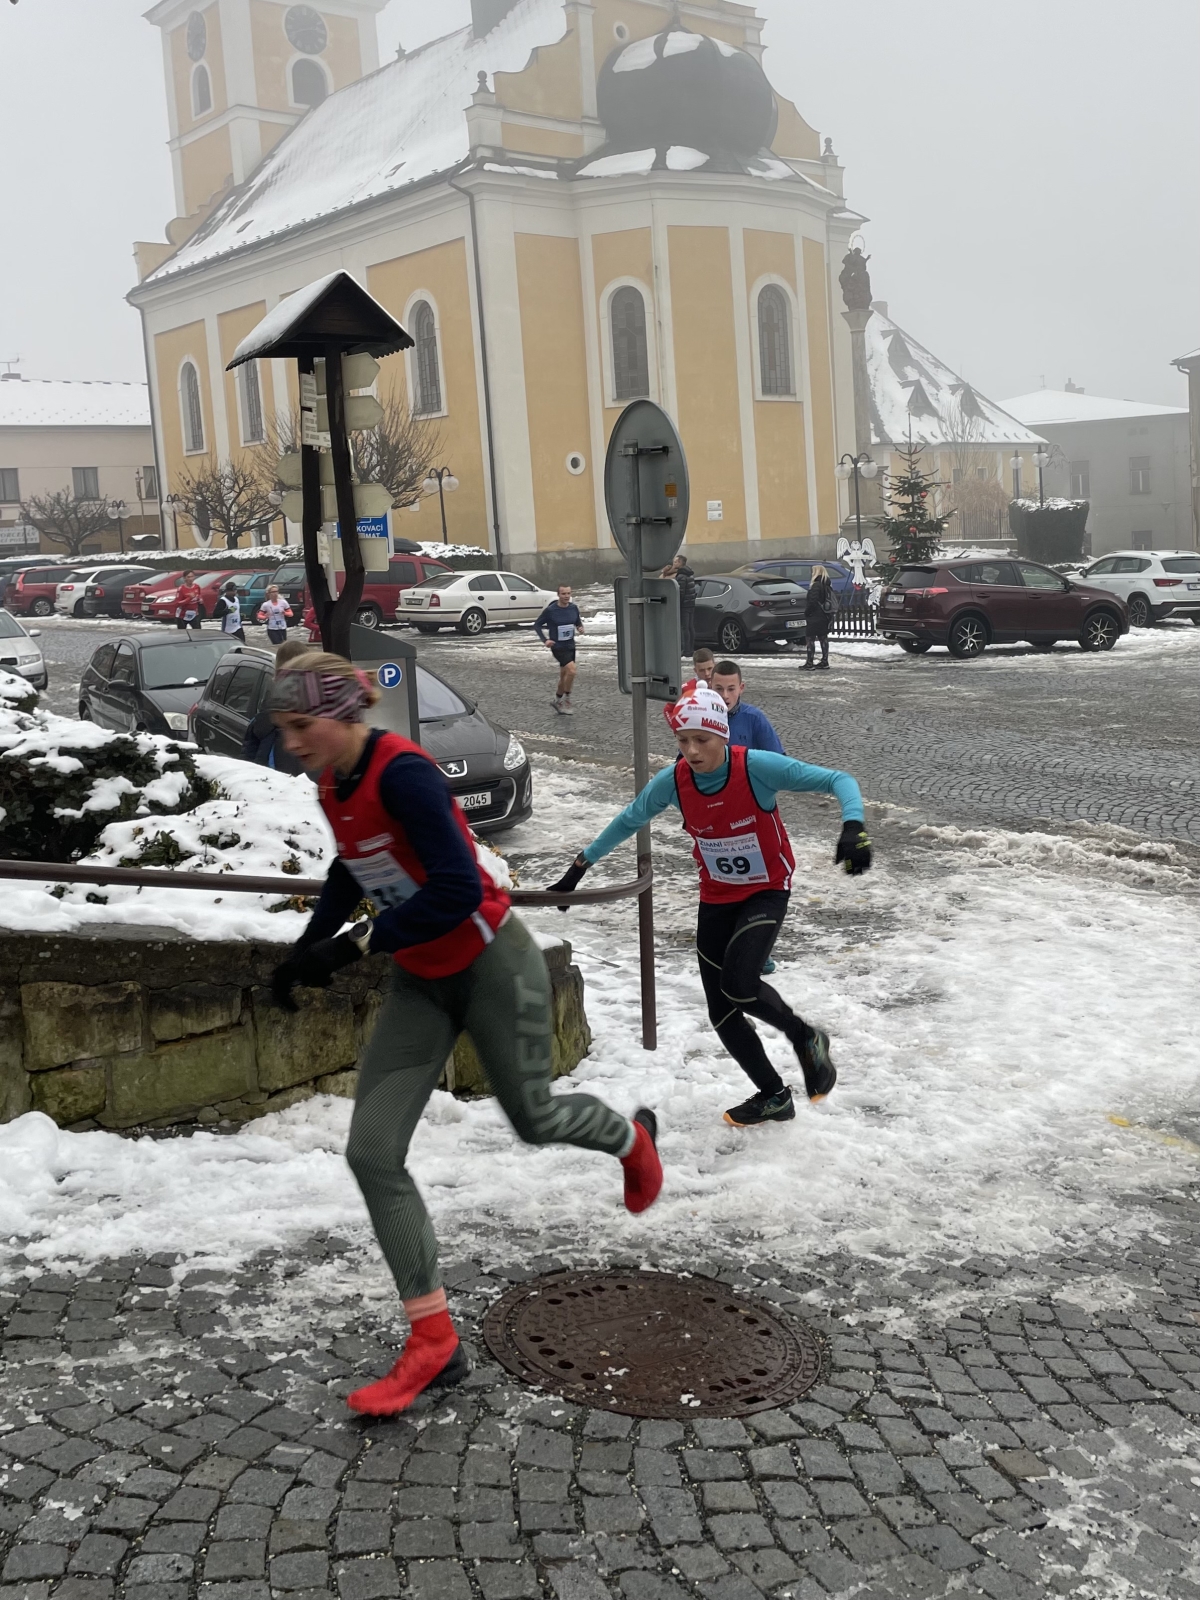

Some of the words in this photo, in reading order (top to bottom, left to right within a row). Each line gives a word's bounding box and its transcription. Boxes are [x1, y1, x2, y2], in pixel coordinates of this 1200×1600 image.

[357, 524, 382, 532] KOVACÍ
[384, 667, 396, 684] P
[464, 794, 486, 806] 2045
[699, 838, 723, 848] ZIMNÍ
[738, 843, 757, 852] LIGA
[716, 857, 751, 875] 69
